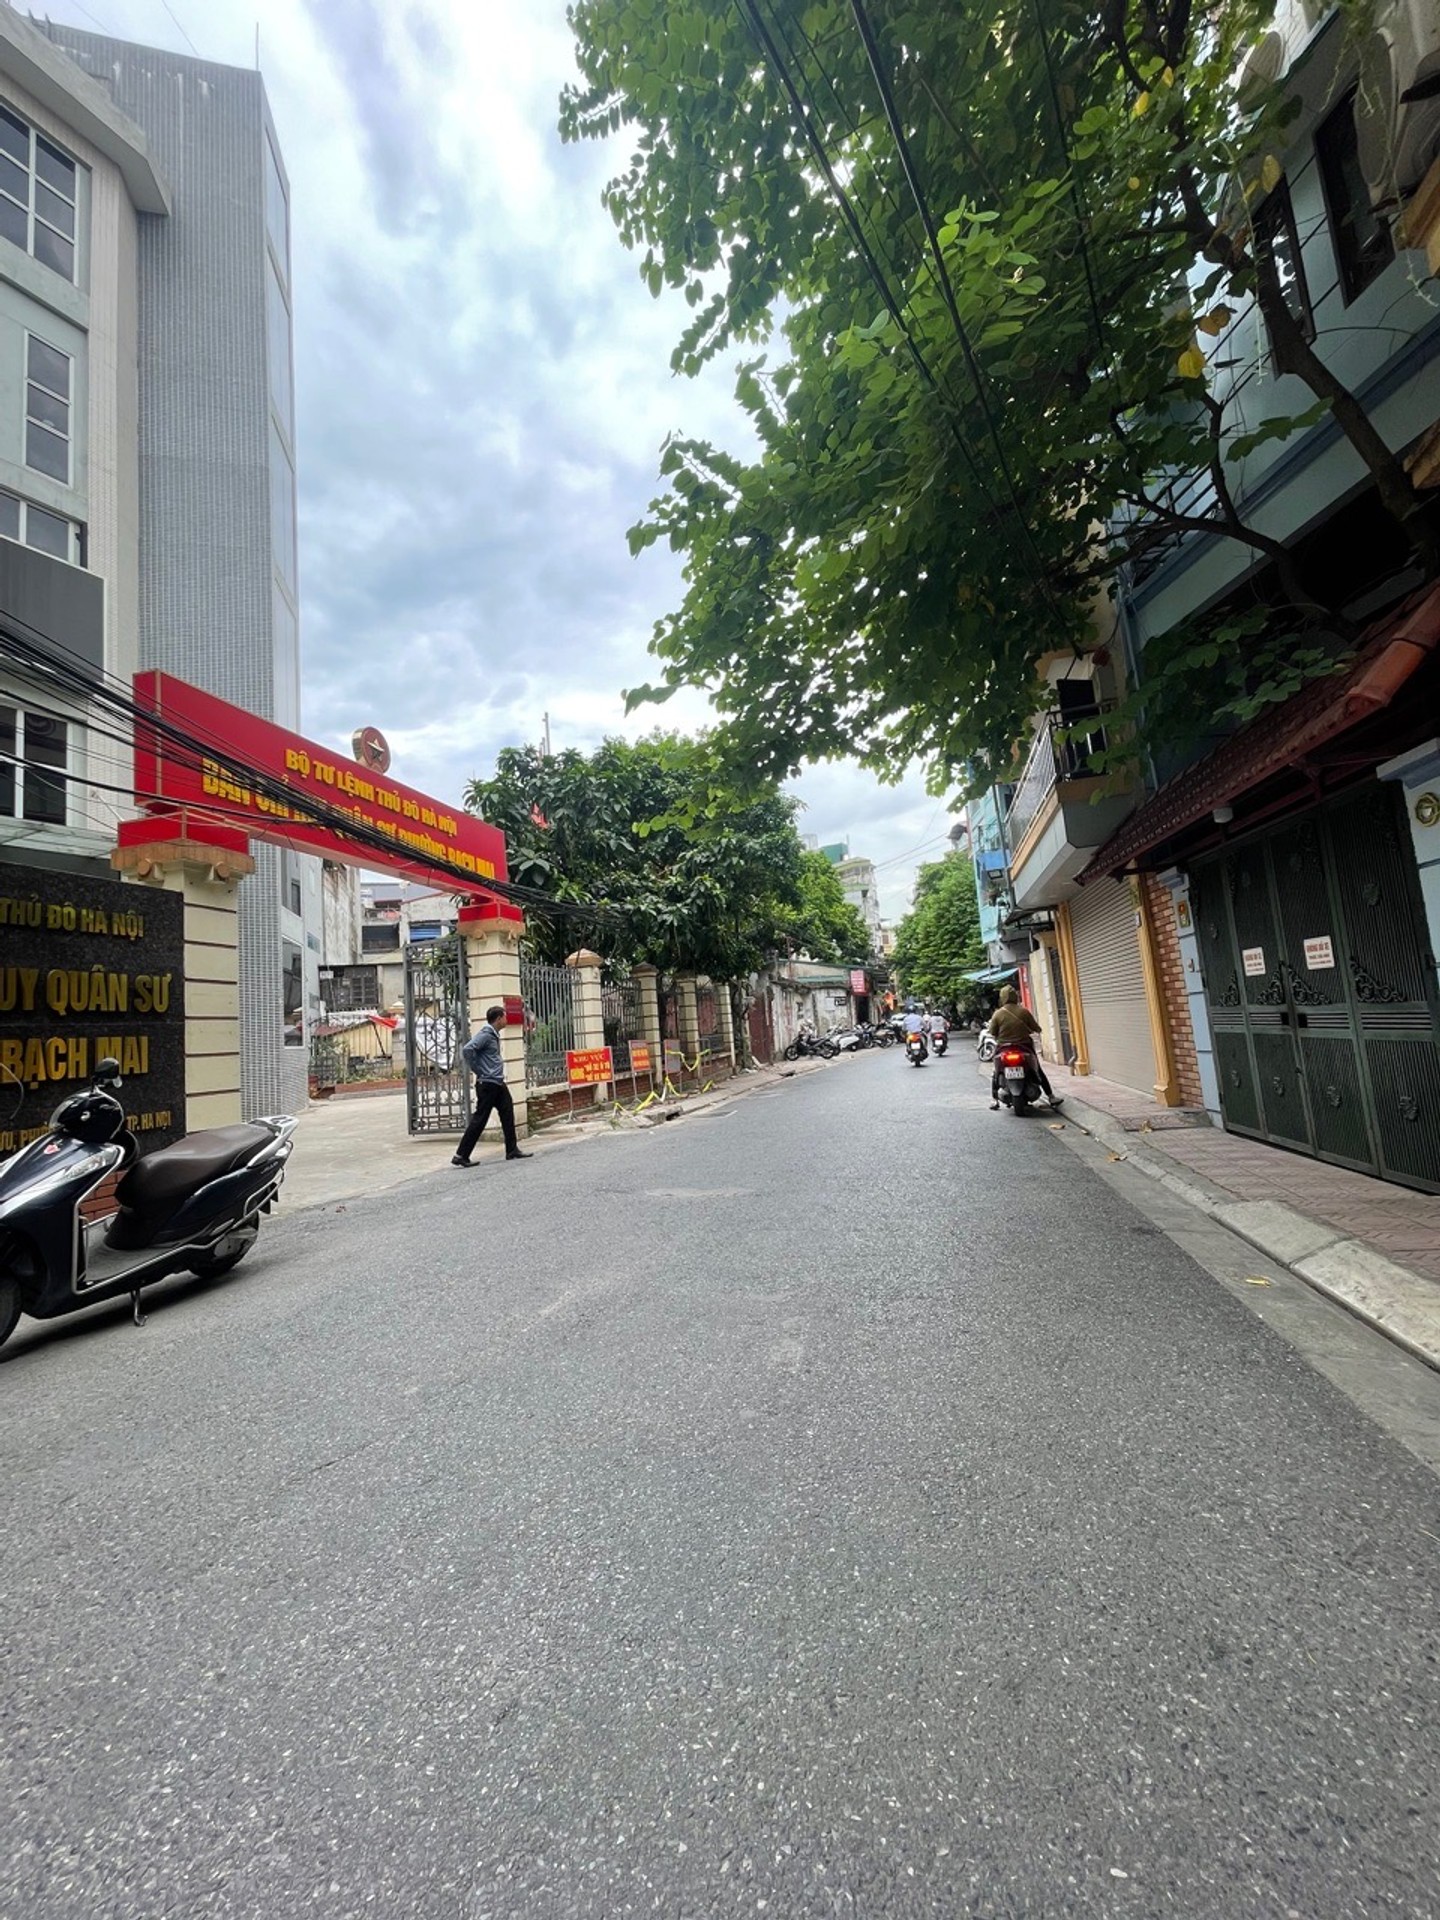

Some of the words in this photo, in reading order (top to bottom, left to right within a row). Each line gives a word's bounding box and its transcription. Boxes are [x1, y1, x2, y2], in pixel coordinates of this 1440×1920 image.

[286, 749, 310, 778] BỘ
[313, 760, 335, 785] TƯ
[337, 770, 374, 802] LỆNH
[376, 787, 401, 813] THỦ
[0, 893, 42, 928] THỦ
[81, 904, 108, 935] HÀ
[112, 909, 144, 941] NỘI
[47, 964, 129, 1016] QUÂN
[1, 1036, 88, 1089] BẠCH
[95, 1035, 149, 1075] MAI
